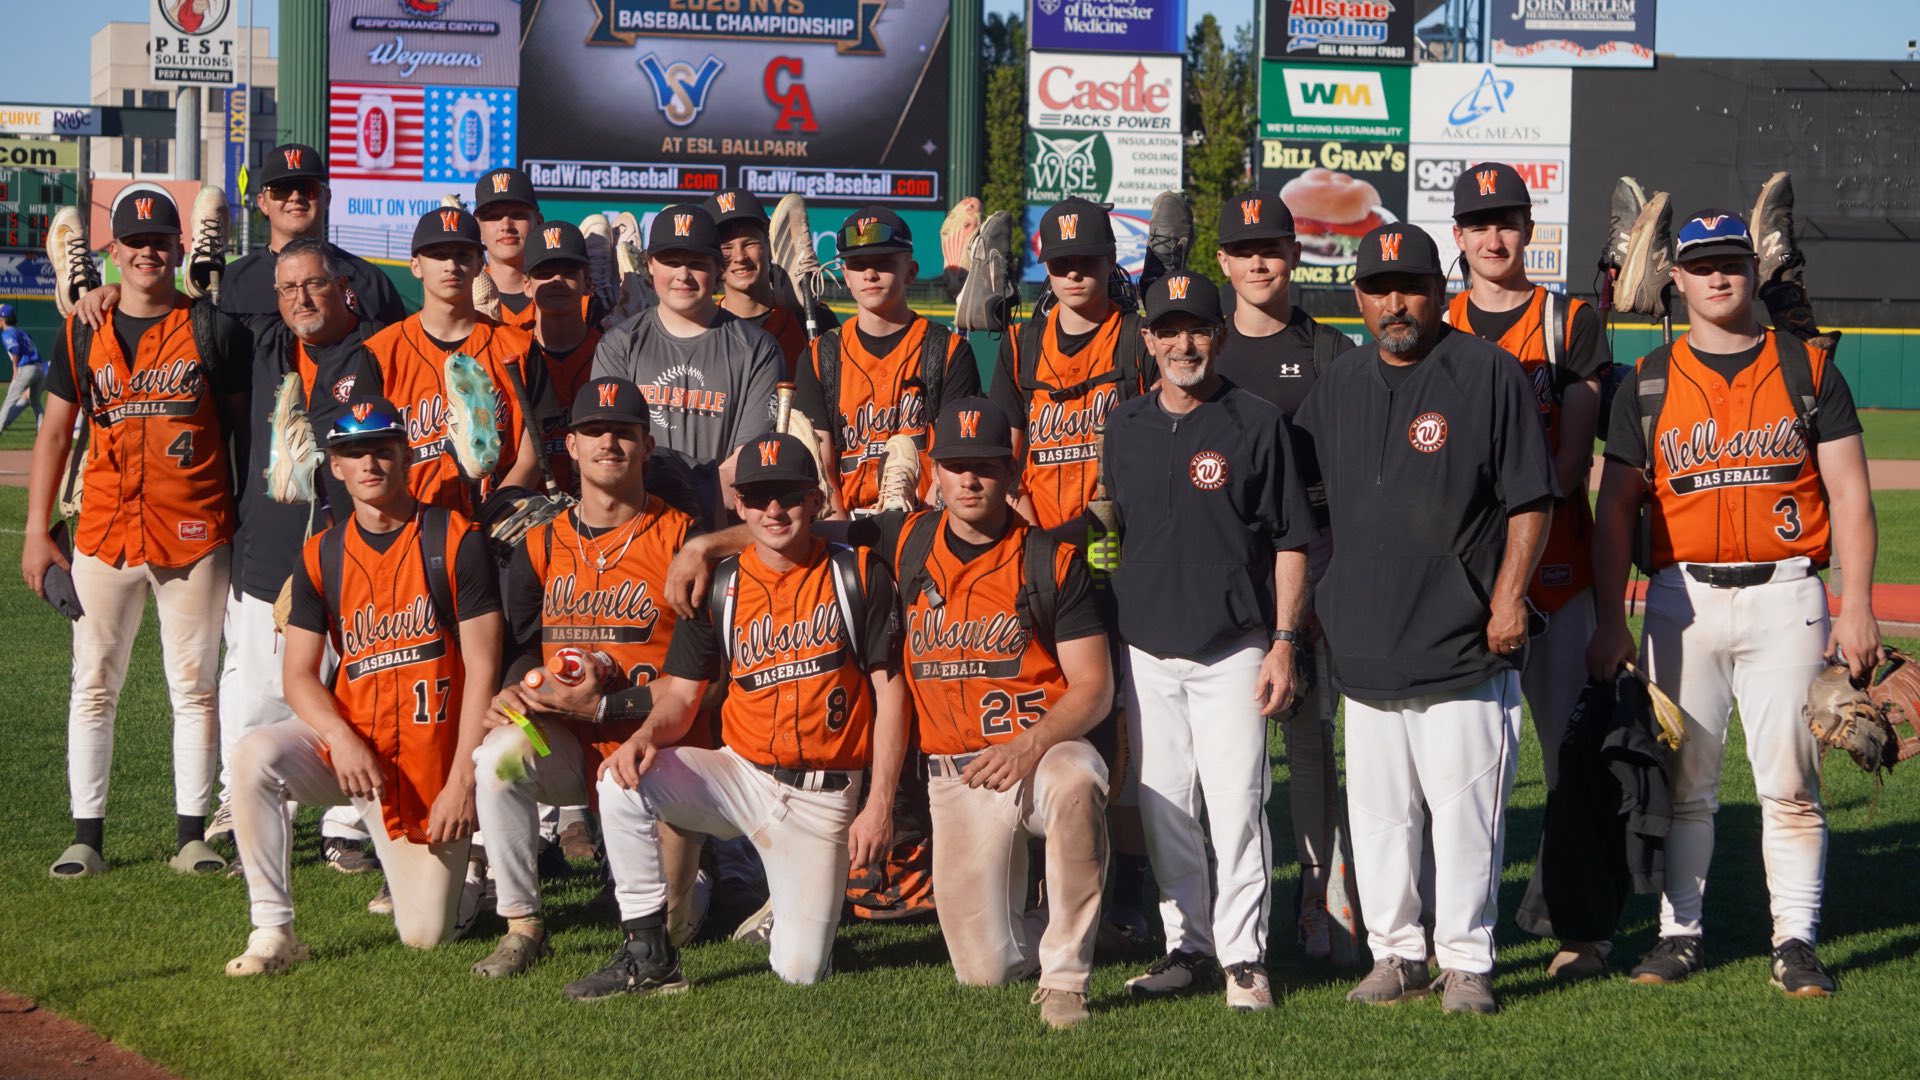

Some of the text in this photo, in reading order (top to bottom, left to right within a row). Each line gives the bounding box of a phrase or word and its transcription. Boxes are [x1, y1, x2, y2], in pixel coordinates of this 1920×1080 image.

[1064, 3, 1154, 20] of Rochester
[1290, 0, 1387, 18] Allstate
[1511, 0, 1566, 20] JOHN
[356, 18, 495, 33] PERFORMANCE CENTER
[619, 10, 854, 36] BASEBALL CHAMPIONSHIP
[1064, 17, 1128, 35] Medicine
[1289, 18, 1387, 41] Roofing
[155, 37, 233, 55] PEST
[155, 55, 229, 67] SOLUTIONS
[367, 35, 483, 78] Wegmans
[158, 69, 230, 81] PEST & WILDLIFE
[1038, 57, 1170, 113] Castle
[1300, 82, 1372, 106] WM
[0, 111, 40, 126] CURVE
[1063, 114, 1171, 128] PACKS POWER
[1296, 124, 1332, 134] DRIVING
[1334, 125, 1403, 137] SUSTAINABILITY
[1486, 127, 1541, 140] MEATS
[661, 137, 808, 157] AT ESL BALLPARK
[1117, 137, 1178, 147] INSULATION
[284, 149, 302, 169] W
[1132, 152, 1178, 161] COOLING
[531, 163, 719, 191] RedWingsBaseball.com
[1030, 163, 1097, 190] WISE
[1134, 168, 1178, 177] HEATING
[1476, 170, 1498, 195] W
[492, 173, 510, 193] W
[747, 169, 931, 197] RedWingsBaseball.com
[716, 192, 735, 213] W
[1026, 187, 1061, 201] Home
[1113, 195, 1138, 205] HEAT
[29, 204, 46, 214] HITS
[135, 198, 154, 219] W
[348, 198, 382, 215] BUILT
[387, 199, 404, 216] ON
[1241, 199, 1262, 224] W
[9, 213, 18, 229] 5
[441, 211, 460, 231] W
[673, 214, 694, 236] W
[1058, 214, 1078, 240] W
[9, 231, 17, 246] 6
[543, 227, 561, 249] W
[1380, 233, 1402, 261] W
[1168, 276, 1190, 300] W
[598, 383, 619, 407] W
[109, 403, 166, 422] BASEBALL
[959, 411, 981, 438] W
[1419, 423, 1438, 442] W
[166, 430, 194, 468] 4
[758, 441, 781, 466] W
[1199, 462, 1219, 480] W
[1773, 496, 1802, 542] 3
[552, 628, 616, 640] BASEBALL
[753, 660, 820, 687] BASEBALL
[413, 676, 450, 724] 17
[826, 685, 848, 732] 8
[980, 688, 1048, 737] 25
